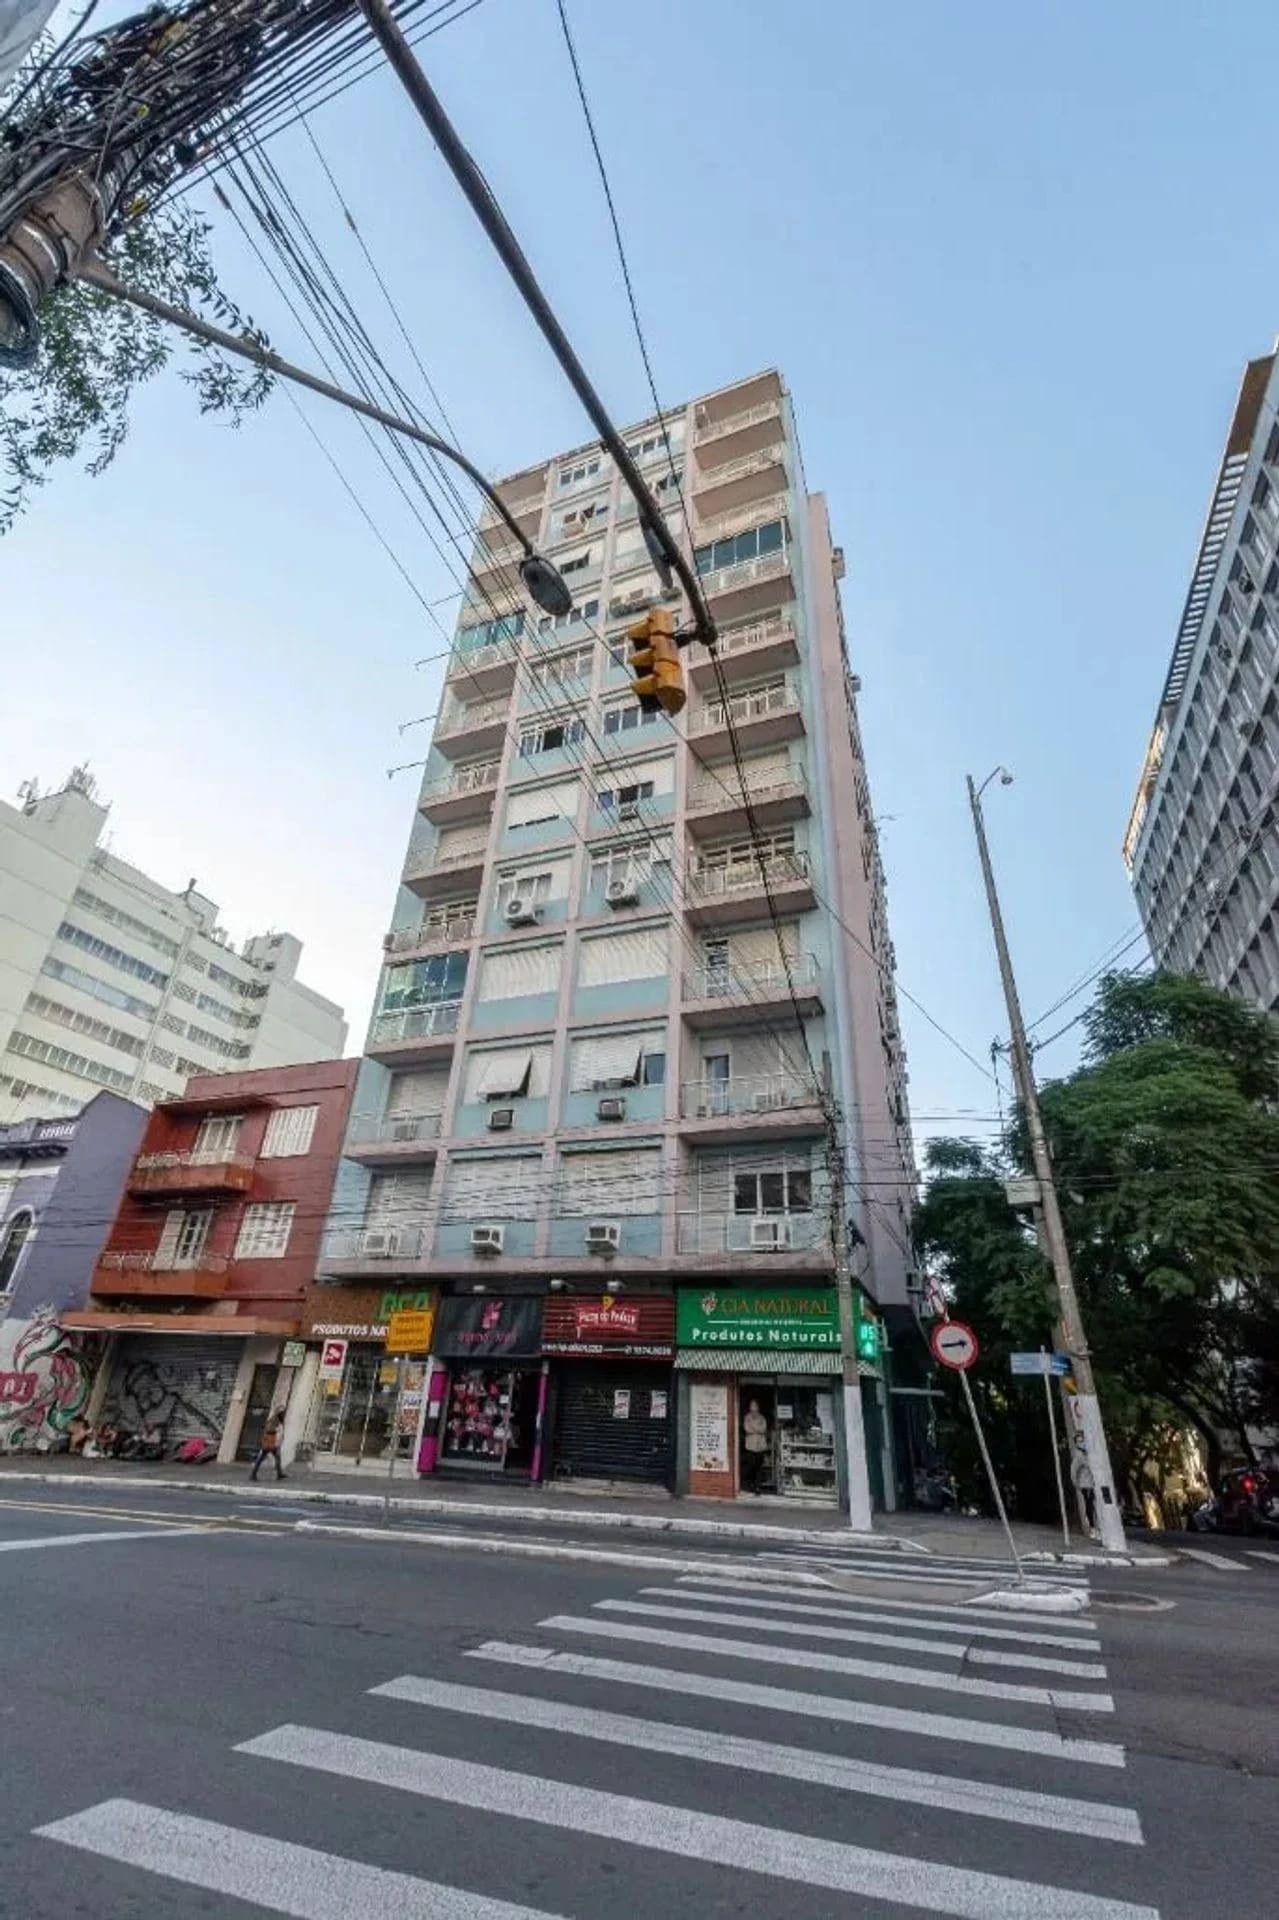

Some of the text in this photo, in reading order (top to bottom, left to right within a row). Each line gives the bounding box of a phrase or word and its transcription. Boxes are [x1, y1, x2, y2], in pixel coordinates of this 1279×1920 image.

[311, 1323, 368, 1335] PRODUTOS
[692, 1327, 843, 1343] Produtos Naturais
